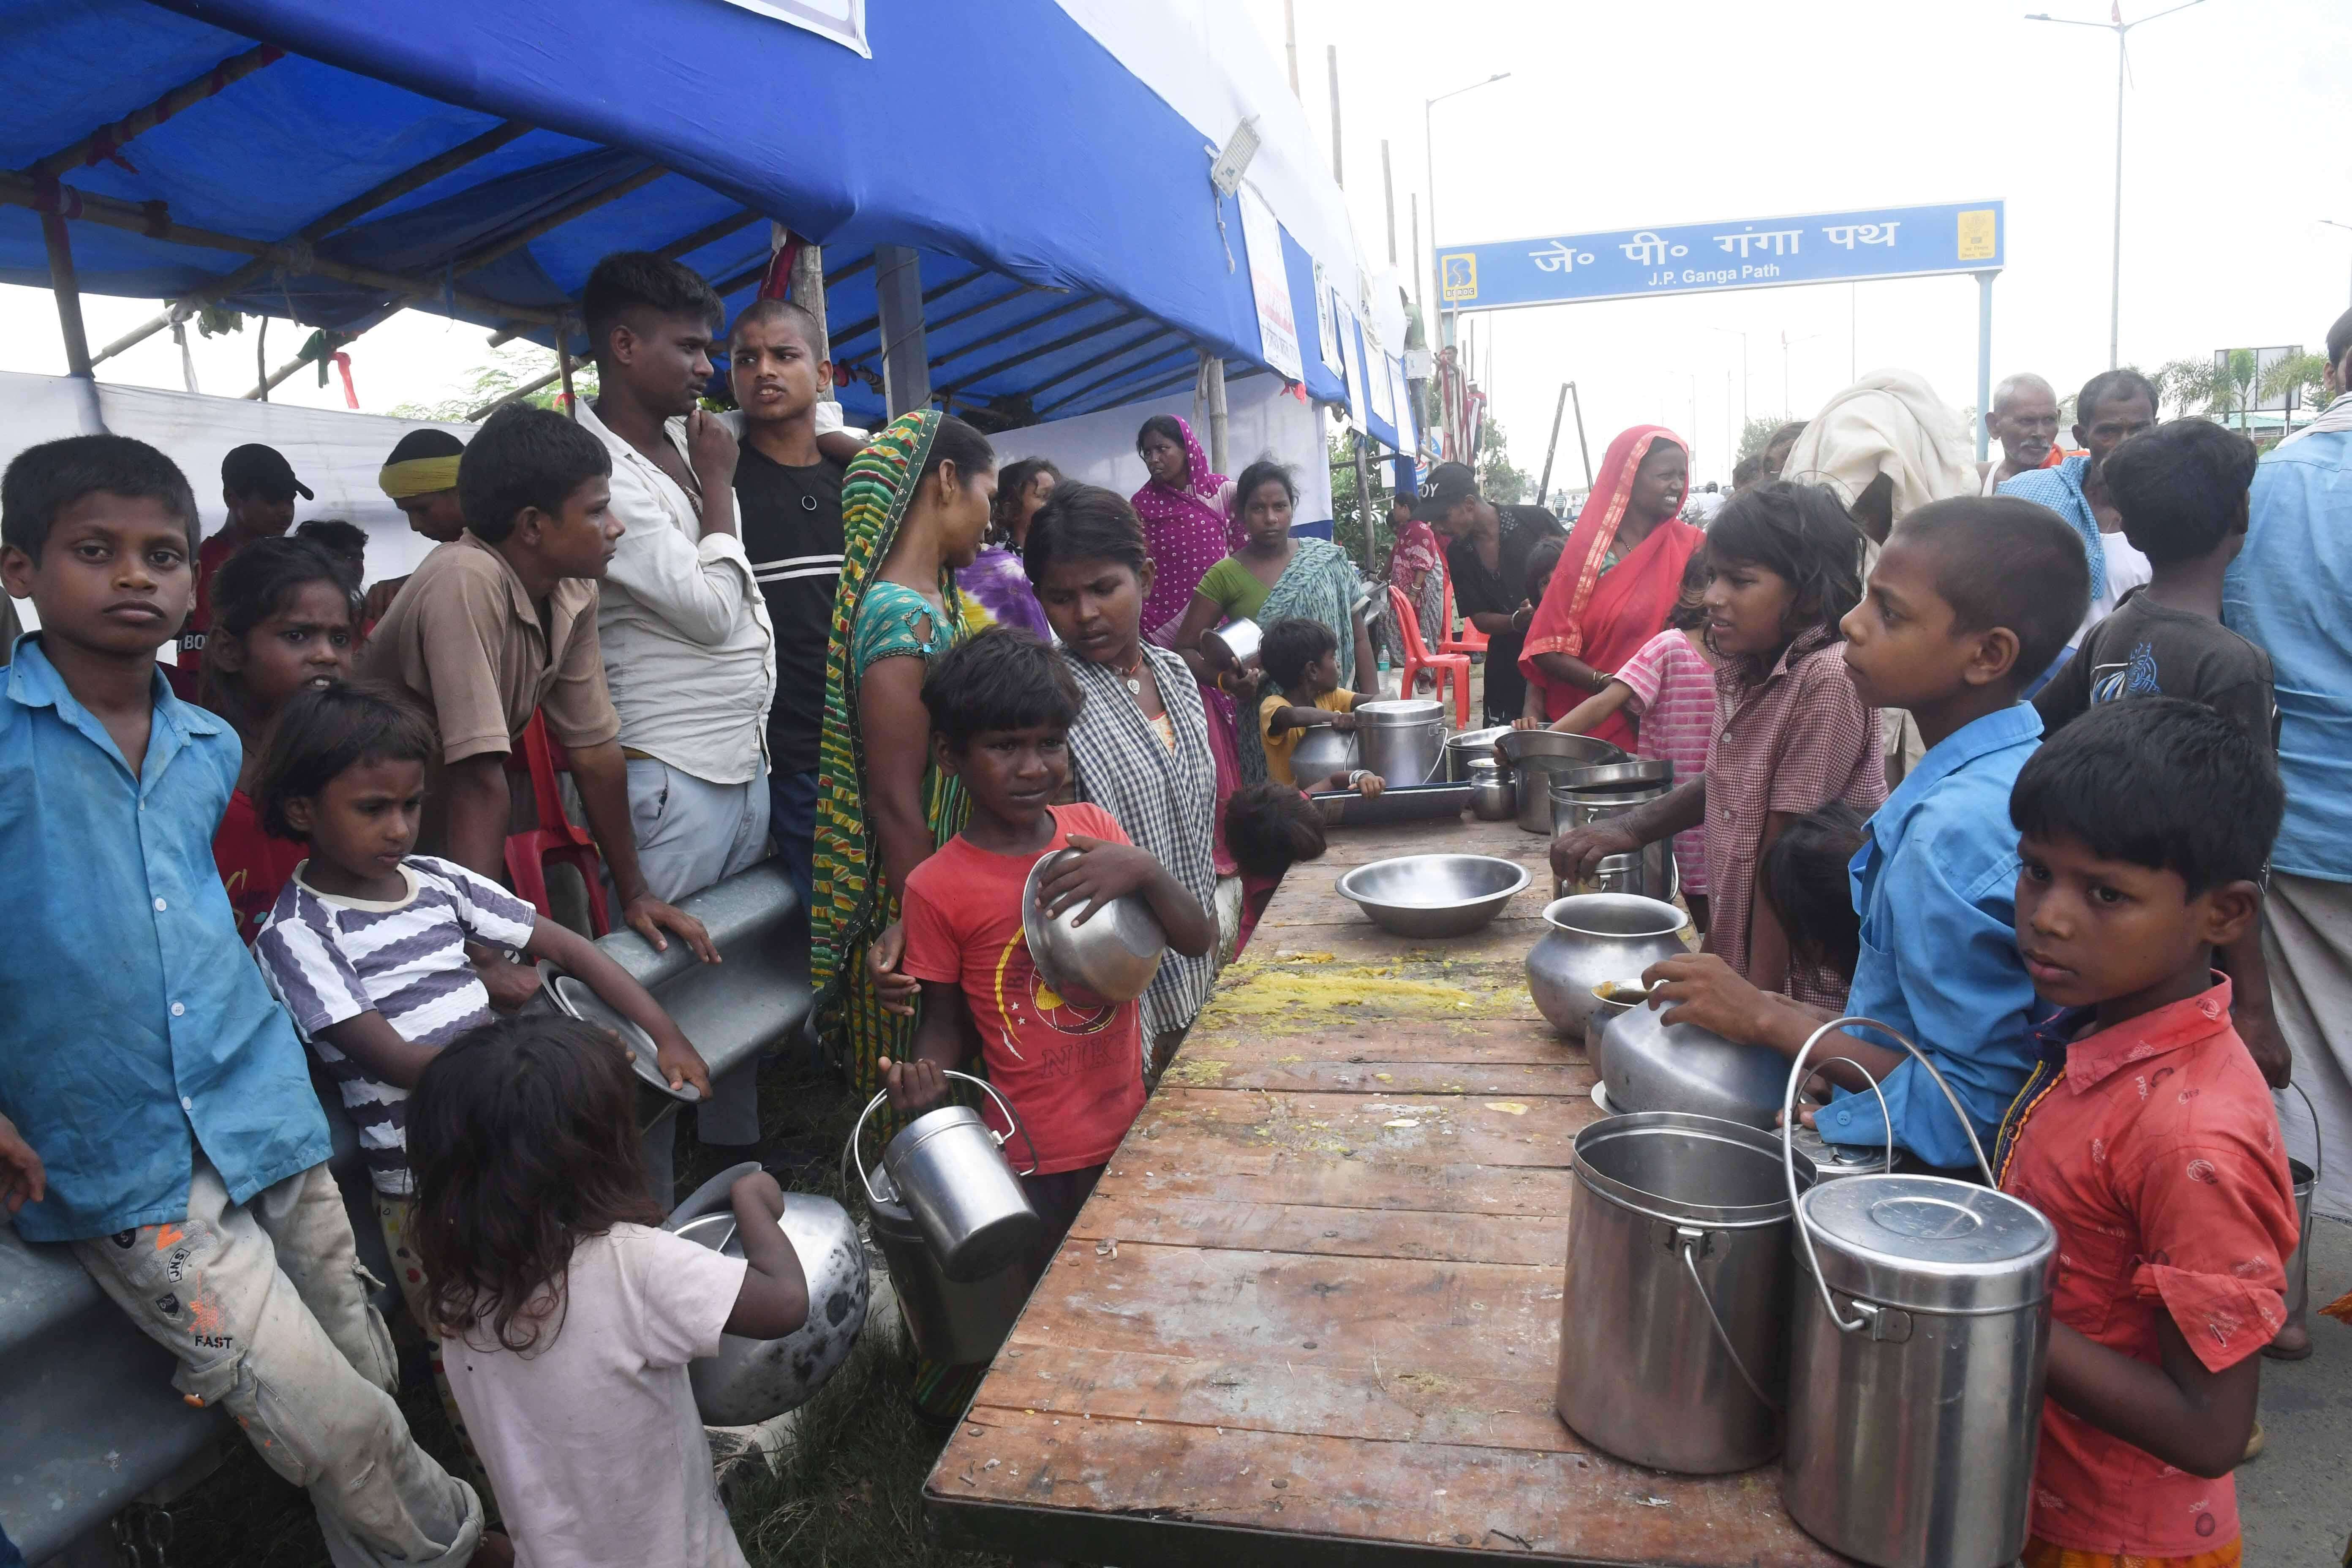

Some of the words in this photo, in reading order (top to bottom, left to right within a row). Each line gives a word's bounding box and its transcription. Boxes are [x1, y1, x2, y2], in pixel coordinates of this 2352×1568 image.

[1713, 226, 1803, 258] गंगा
[1822, 222, 1900, 250] पथ
[1648, 271, 1677, 286] J.P.
[1682, 270, 1737, 284] Ganga
[1742, 264, 1780, 278] Path
[169, 1253, 185, 1277] JNS
[195, 1335, 233, 1349] FAST
